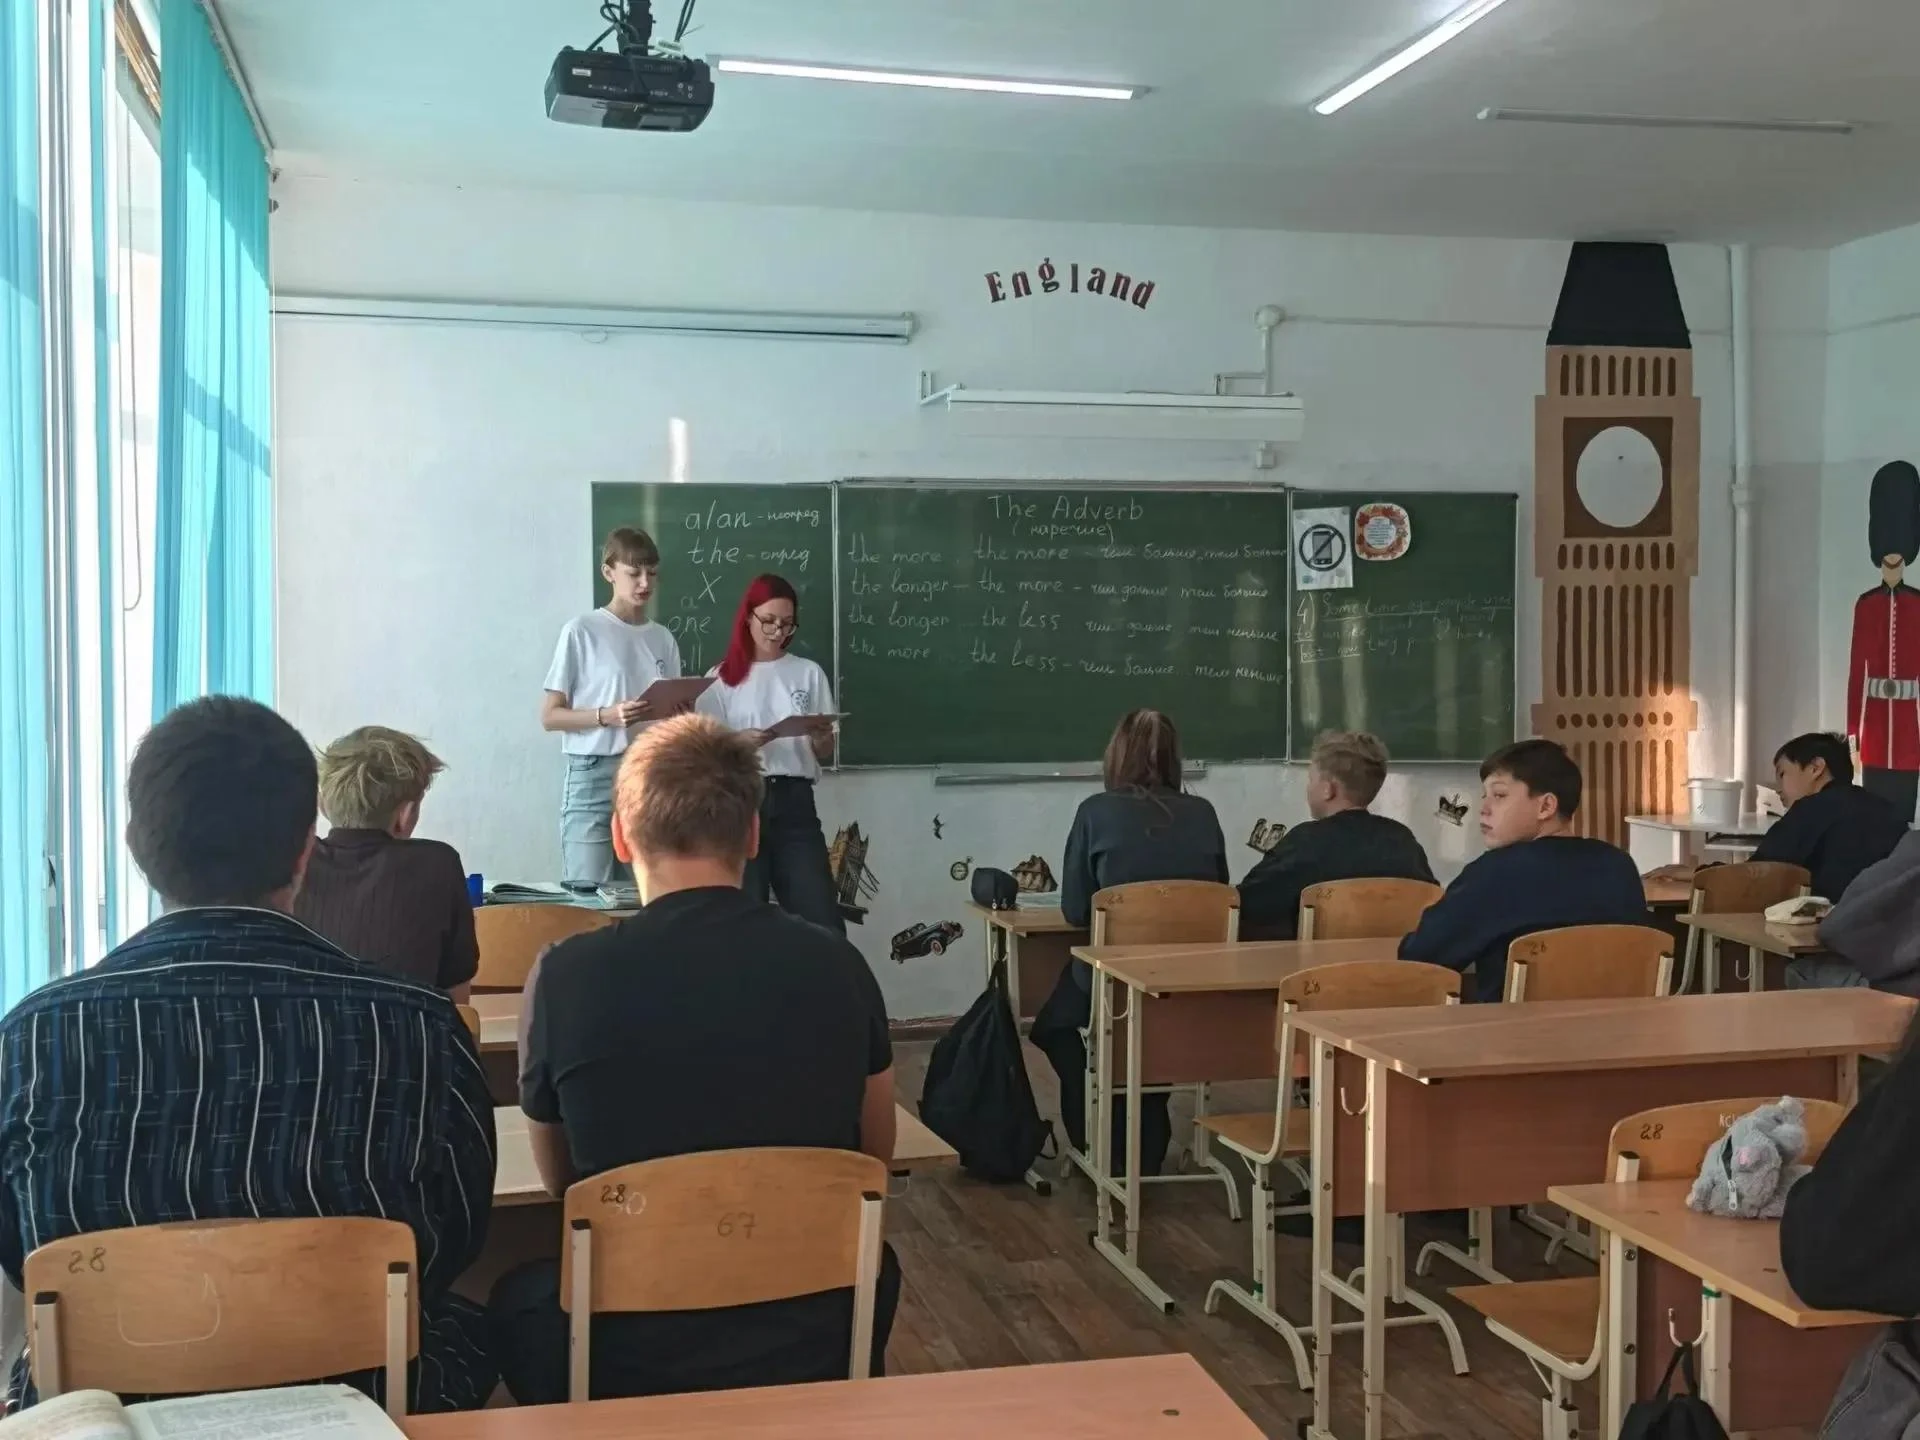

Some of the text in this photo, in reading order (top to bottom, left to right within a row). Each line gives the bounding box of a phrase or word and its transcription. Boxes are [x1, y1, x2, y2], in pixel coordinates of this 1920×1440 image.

[984, 257, 1155, 310] England
[988, 495, 1143, 520] The Adverb
[687, 536, 740, 564] the
[848, 532, 881, 563] the
[892, 551, 943, 563] more
[975, 533, 1008, 560] the
[1015, 547, 1069, 561] more
[851, 567, 882, 595] the
[890, 567, 949, 602] longer
[976, 566, 1006, 593] the
[1018, 580, 1064, 592] more
[849, 603, 876, 626] the
[887, 600, 950, 637] longer
[982, 605, 1007, 627] the
[1018, 600, 1061, 631] less
[849, 634, 877, 657] the
[887, 647, 932, 659] more
[970, 636, 998, 664] the
[1011, 638, 1058, 672] less
[1640, 1123, 1664, 1140] 28
[601, 1184, 626, 1204] 28
[717, 1211, 758, 1240] 67
[68, 1247, 107, 1274] 28
